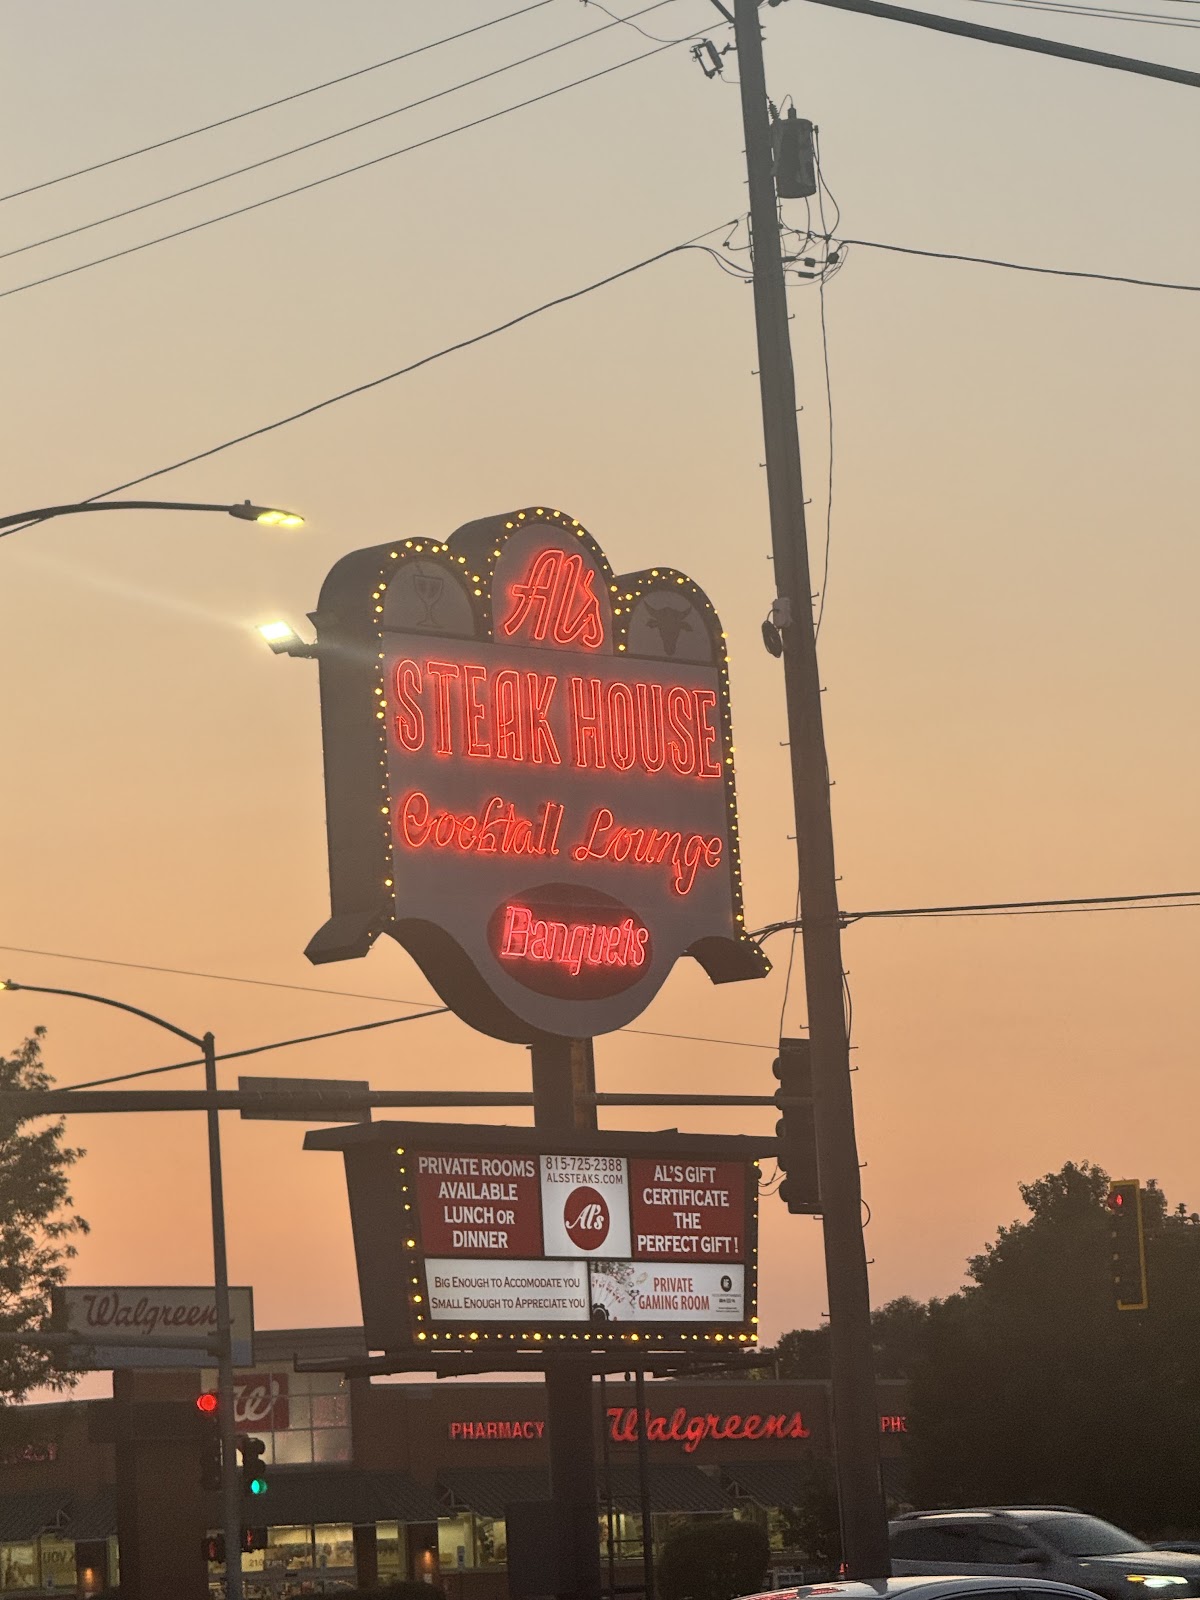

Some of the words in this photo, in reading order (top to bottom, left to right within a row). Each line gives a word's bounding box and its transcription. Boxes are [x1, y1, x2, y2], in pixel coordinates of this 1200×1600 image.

[504, 549, 605, 648] Al's
[396, 659, 561, 765] STEAK
[570, 676, 722, 778] HOUSE
[573, 808, 723, 895] Lounge
[501, 905, 650, 976] Banquets
[418, 1156, 479, 1176] PRIVATE
[481, 1158, 536, 1178] ROOMS
[545, 1157, 623, 1172] 815-725-2388
[653, 1164, 684, 1183] AL'S
[685, 1166, 717, 1184] GIFT
[546, 1173, 624, 1185] ALSSTEAKS.COM
[438, 1181, 519, 1201] AVAILABLE
[642, 1187, 730, 1207] CERTIFICATE
[444, 1205, 495, 1224] LUNCH
[496, 1210, 516, 1225] OR
[565, 1203, 605, 1230] Al's
[672, 1212, 702, 1230] THE
[452, 1230, 509, 1248] DINNER
[637, 1234, 699, 1253] PERFECT
[653, 1277, 694, 1293] PRIVATE
[638, 1295, 679, 1310] GAMING
[681, 1295, 710, 1310] ROOM
[82, 1292, 235, 1335] Walgreen
[449, 1421, 545, 1440] PHARMACY
[606, 1407, 811, 1453] Walgreens
